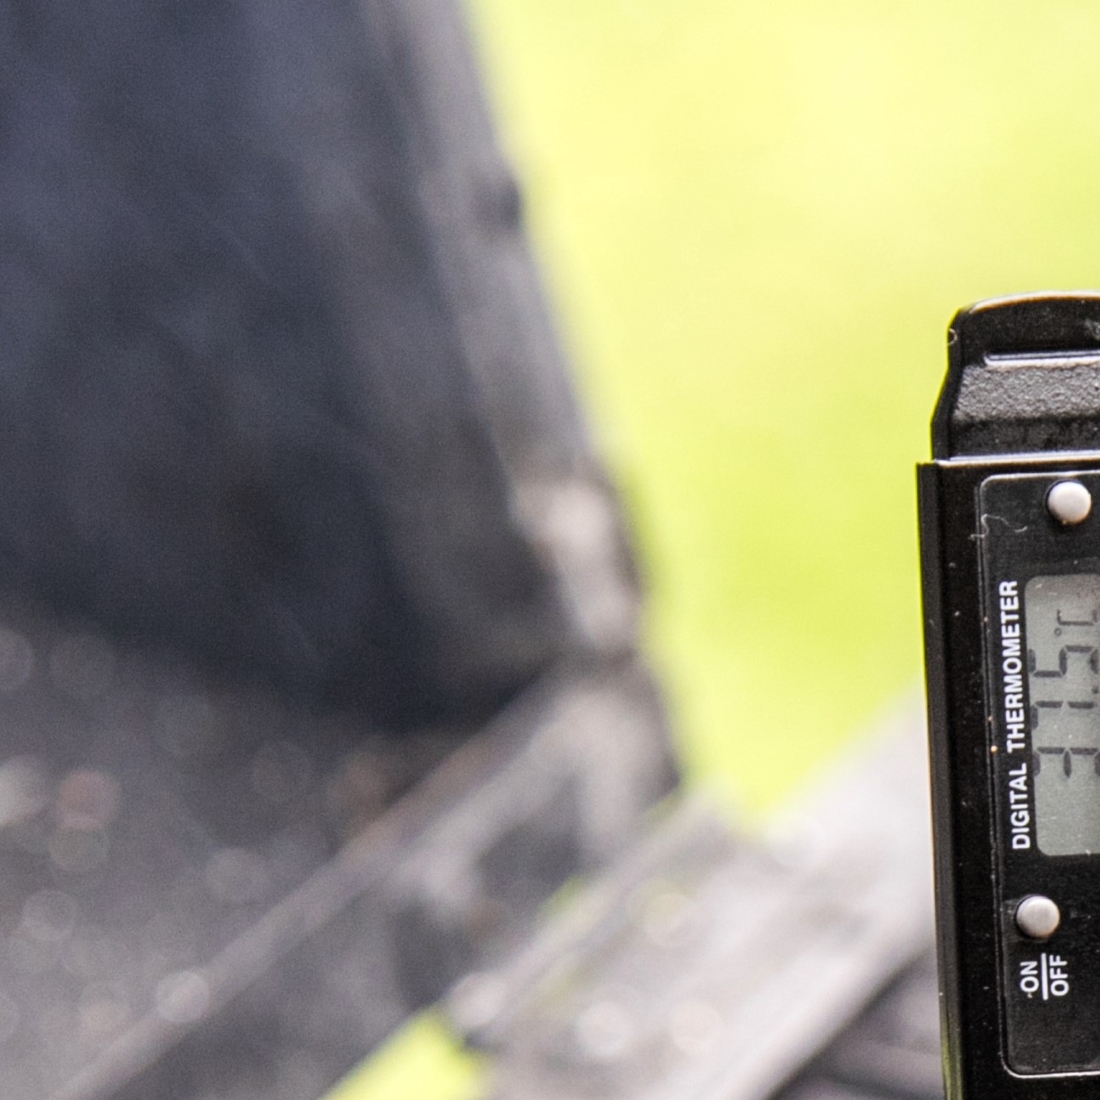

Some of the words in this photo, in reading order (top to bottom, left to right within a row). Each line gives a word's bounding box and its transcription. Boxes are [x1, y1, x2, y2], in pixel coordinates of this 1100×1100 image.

[999, 580, 1026, 753] THERMOMETER
[1009, 763, 1031, 849] DIGITAL
[1020, 961, 1039, 994] ON
[1050, 955, 1069, 996] OFF
